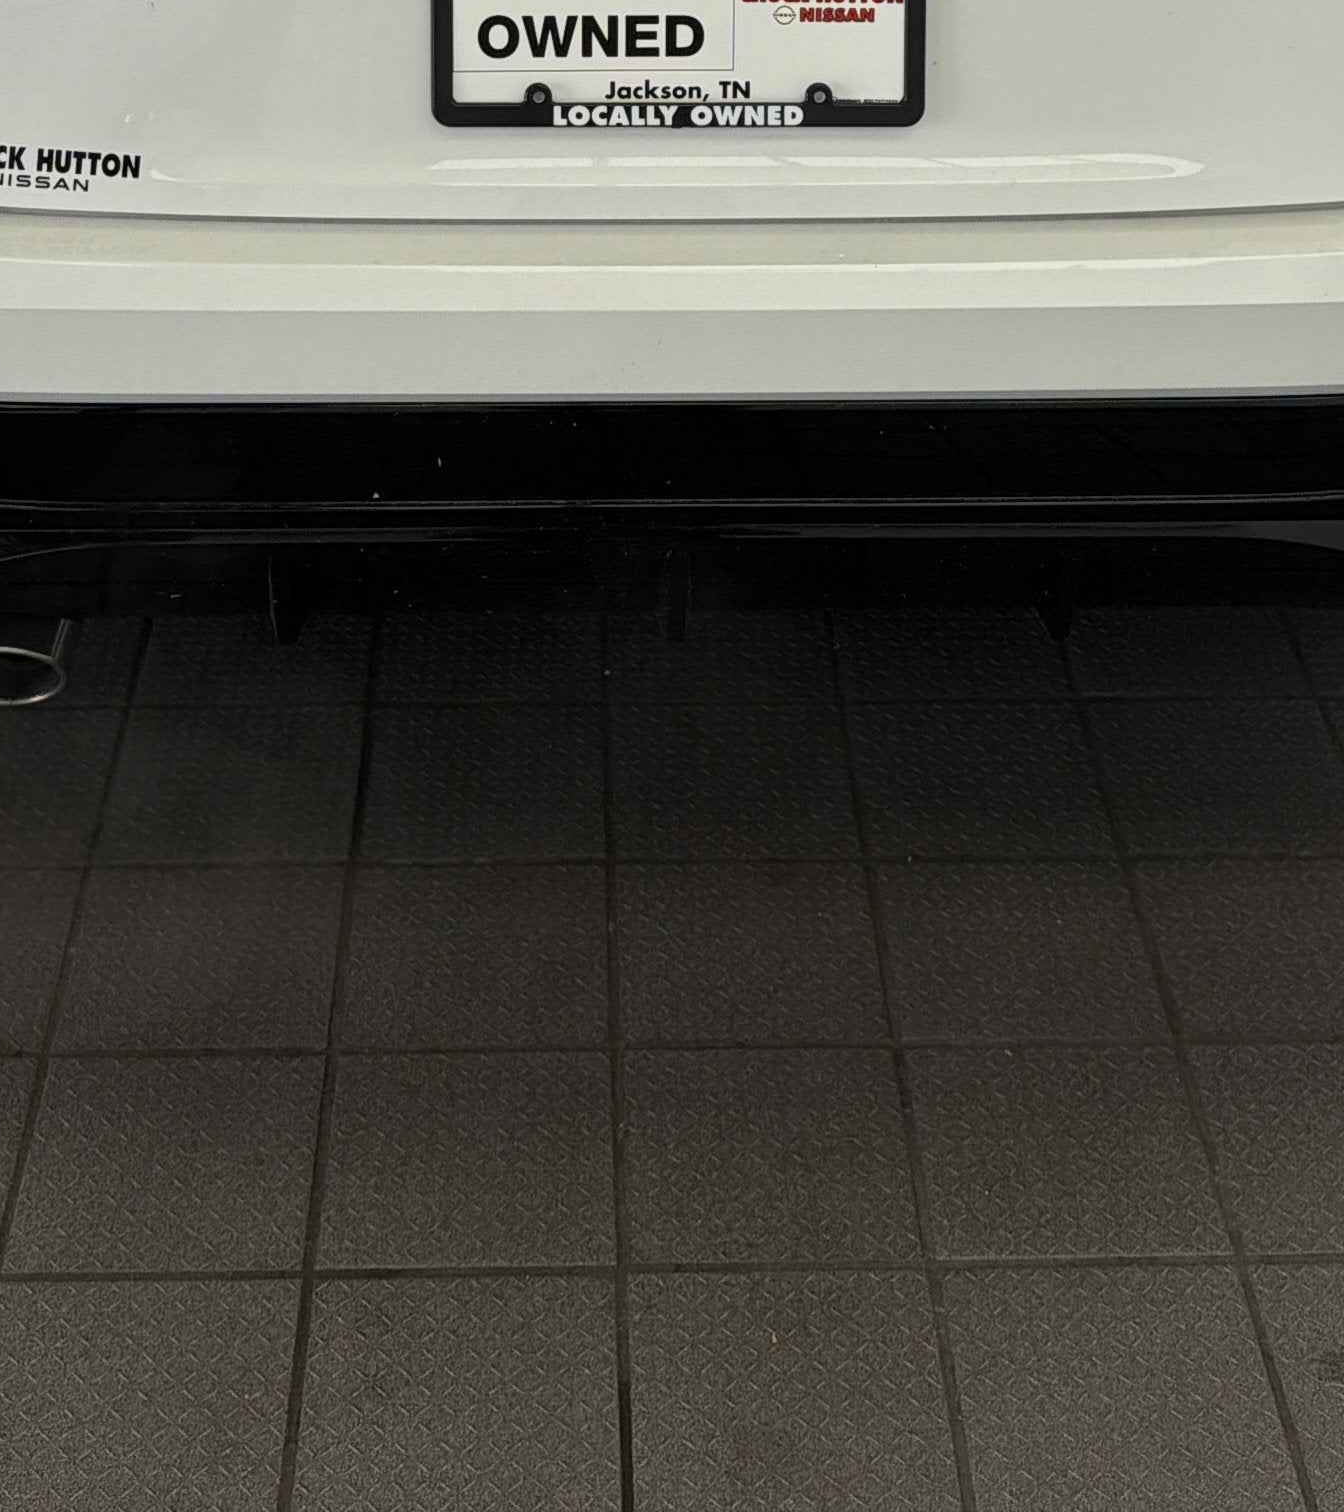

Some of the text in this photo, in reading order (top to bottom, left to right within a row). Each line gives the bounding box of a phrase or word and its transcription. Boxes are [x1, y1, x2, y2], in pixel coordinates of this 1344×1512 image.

[799, 7, 875, 23] NISSAN
[476, 14, 706, 59] OWNED
[604, 79, 751, 102] Jackson, TN
[552, 105, 804, 126] LOCALLY OWNED
[36, 148, 141, 179] HUTTON
